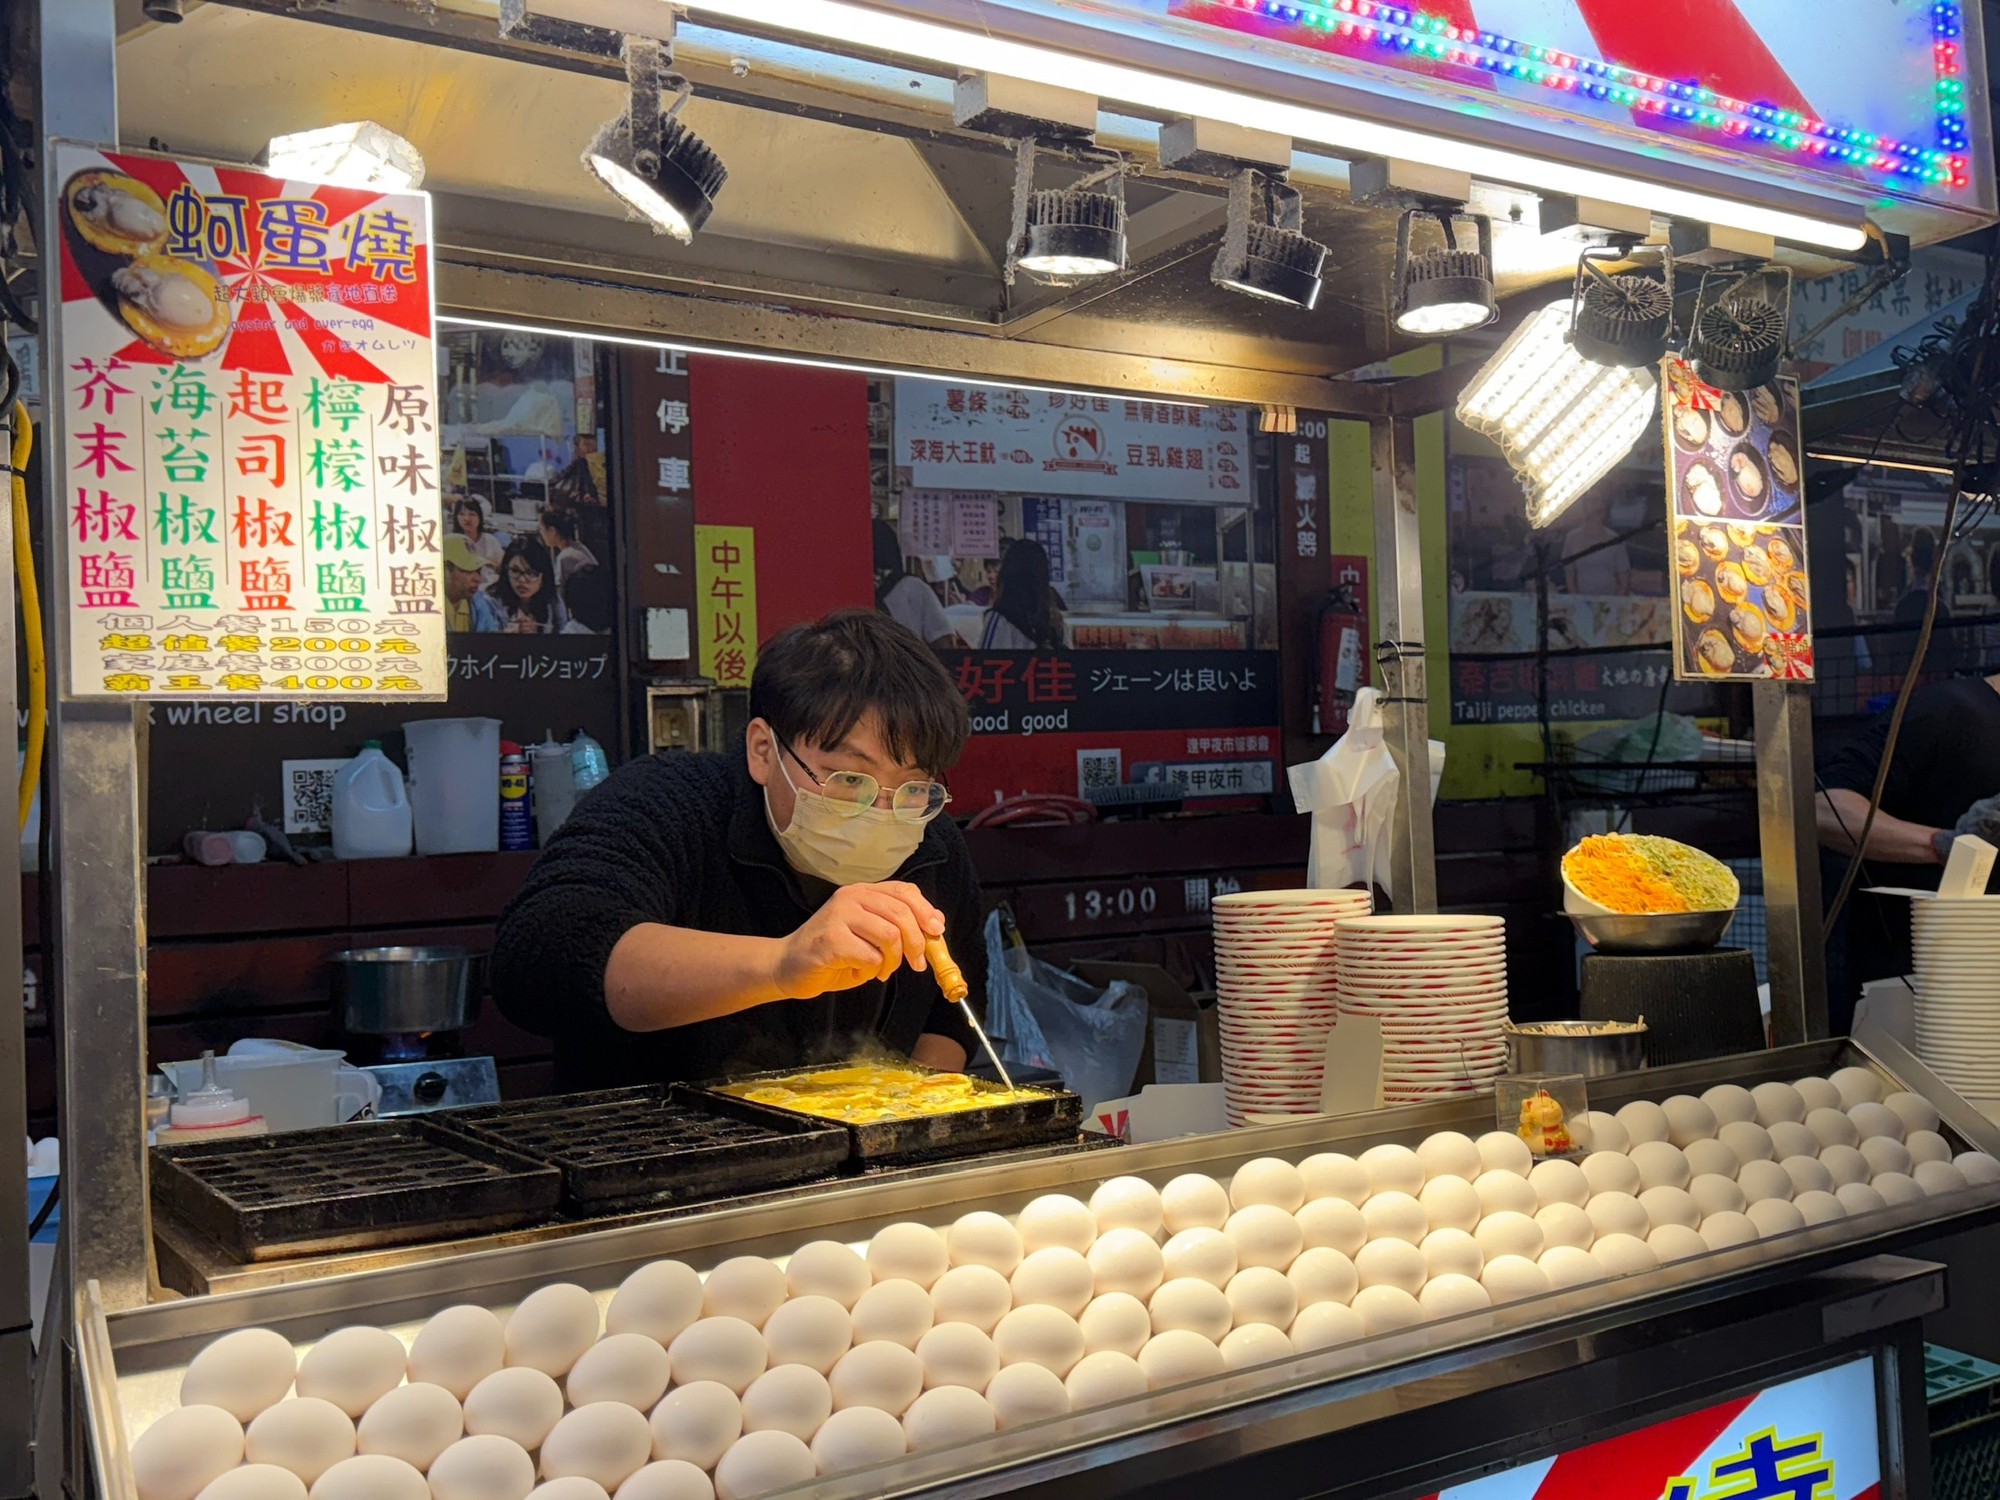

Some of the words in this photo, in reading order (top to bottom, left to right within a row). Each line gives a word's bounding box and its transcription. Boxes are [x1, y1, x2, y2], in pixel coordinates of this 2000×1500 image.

[168, 185, 417, 283] 蚵蛋燒
[231, 318, 276, 331] oyster
[285, 317, 307, 330] and
[314, 318, 375, 332] over-egg
[946, 389, 988, 415] 薯條
[70, 356, 141, 609] 芥末椒鹽
[150, 363, 221, 611] 海苔椒鹽
[227, 368, 297, 612] 起司椒鹽
[302, 376, 371, 614] 檸檬椒鹽
[377, 384, 442, 616] 原味椒鹽
[96, 612, 422, 637] 個人餐150元
[711, 539, 747, 683] 中午以後
[98, 633, 422, 655] 超值餐200元
[101, 653, 423, 674] 家庭餐300元
[102, 673, 423, 692] 霸王餐400元
[955, 655, 1078, 704] 好佳
[1089, 667, 1258, 693] ジェーンは良いよ
[168, 700, 261, 726] wheel
[273, 702, 346, 730] shop
[968, 709, 1009, 736] ood
[1021, 708, 1069, 737] good
[1455, 701, 1492, 722] Taiji
[1498, 703, 1540, 721] peppe
[1551, 700, 1605, 716] chicken
[1063, 886, 1157, 921] 13:00
